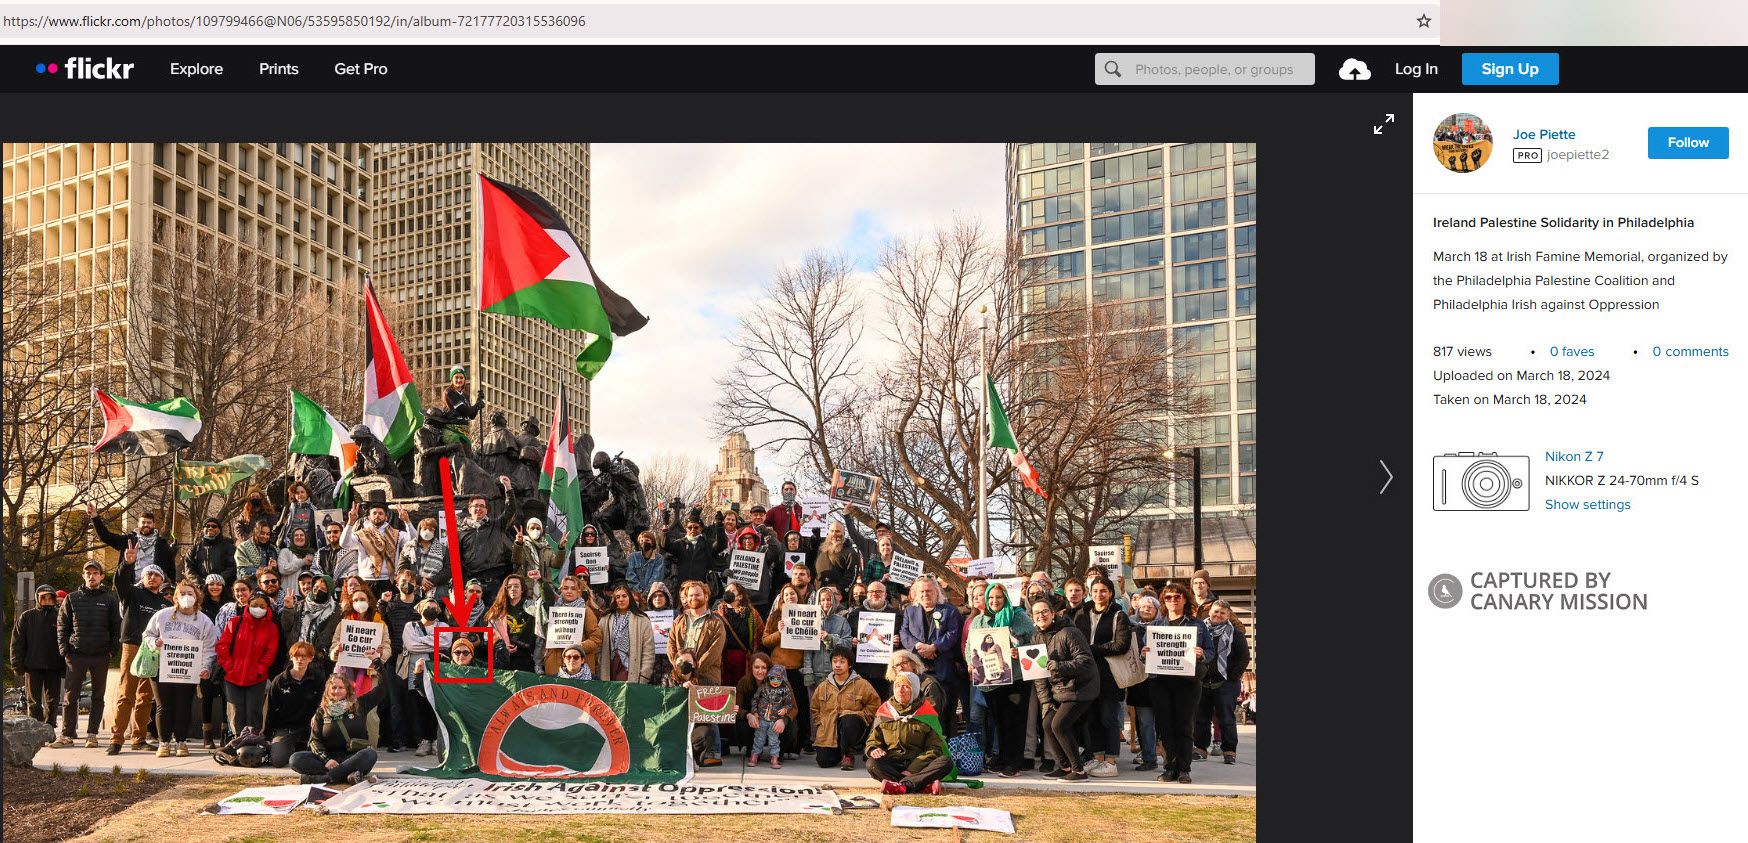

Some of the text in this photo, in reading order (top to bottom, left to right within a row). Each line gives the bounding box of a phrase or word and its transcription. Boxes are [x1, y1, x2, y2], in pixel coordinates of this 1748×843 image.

[3, 14, 586, 30] https://www.flickr.com/photos/109799466@N06/53595850192/in/album-72177720315536096
[64, 56, 135, 80] flickr
[170, 62, 224, 78] Explore
[259, 62, 300, 76] Prints
[334, 62, 388, 76] Get Pro
[1135, 64, 1293, 79] Photos, people, or groups
[1395, 62, 1439, 79] Log In
[1481, 62, 1540, 79] Sign Up
[1512, 128, 1577, 140] Joe Piette
[1668, 136, 1710, 149] Follow
[1517, 151, 1539, 160] PRO
[1546, 149, 1610, 163] joepiette2
[1433, 216, 1695, 231] Ireland Palestine Solidarity in Philadelphia
[1433, 250, 1729, 265] March 18 at Irish Famine Memorial, organized by
[1432, 274, 1675, 289] the Philadelphia Palestine Coalition and
[1433, 298, 1660, 313] Philadelphia Irish against Oppression
[1433, 345, 1493, 357] 817 views
[1549, 345, 1595, 357] 0 faves
[1652, 345, 1730, 357] 0 comments
[1433, 369, 1611, 384] Uploaded on March 18, 2024
[1432, 393, 1587, 407] Taken on March 18, 2024
[1545, 450, 1604, 462] Nikon Z 7
[1545, 474, 1700, 486] NIKKOR Z 24-70mm f/4 S
[1545, 499, 1632, 513] Show settings
[734, 554, 756, 563] IRELAND
[733, 561, 760, 570] PALESTINE
[893, 560, 919, 572] PALESTINE
[797, 610, 817, 618] neart
[791, 617, 801, 626] Go
[355, 626, 377, 636] neart
[786, 626, 793, 635] le
[1152, 632, 1173, 640] There
[348, 634, 373, 644] Go cur
[1156, 641, 1187, 649] strength
[163, 643, 183, 652] There
[183, 644, 190, 652] is
[342, 643, 350, 652] le
[1157, 649, 1186, 657] without
[167, 660, 193, 668] without
[1161, 657, 1180, 666] unity
[171, 667, 189, 675] unity
[490, 688, 625, 746] ALWAYS AND FOREVER
[692, 711, 738, 723] Palestine
[483, 782, 543, 792] Irish
[546, 782, 651, 793] Against
[658, 783, 823, 795] Oppression!
